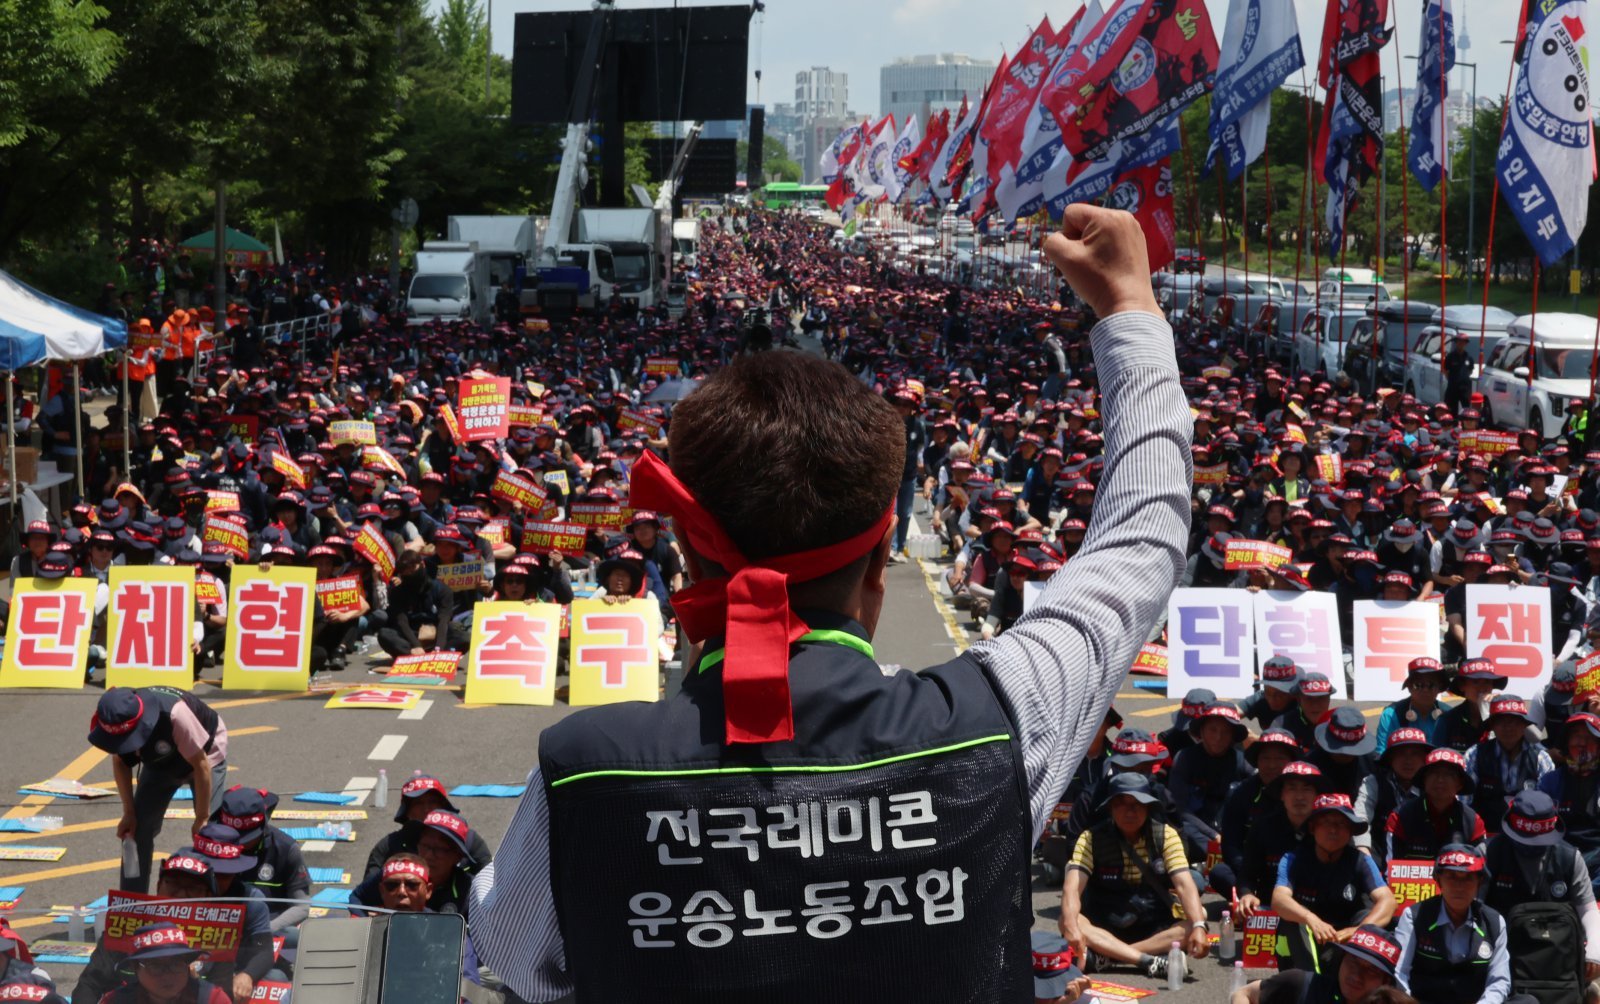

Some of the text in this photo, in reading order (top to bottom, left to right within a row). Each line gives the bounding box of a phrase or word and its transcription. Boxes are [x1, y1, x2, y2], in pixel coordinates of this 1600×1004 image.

[1498, 134, 1558, 240] 용인지부
[232, 532, 248, 553] 촉구한
[524, 532, 584, 550] 강력히 촉구한다
[1226, 550, 1254, 562] 강력히
[18, 594, 86, 668] 단
[115, 584, 184, 667] 체
[239, 583, 304, 668] 협
[327, 590, 358, 606] 촉구한다
[480, 614, 547, 686] 촉
[580, 616, 648, 686] 구
[1177, 604, 1247, 678] 단
[1364, 616, 1428, 682] 투
[1477, 602, 1544, 678] 쟁
[644, 790, 938, 866] 전국레미콘
[194, 906, 242, 924] 단체교섭
[627, 866, 969, 948] 운송노동조합
[1246, 916, 1280, 930] 레미콘
[1391, 882, 1436, 904] 강력히
[108, 915, 239, 950] 강력 구한다
